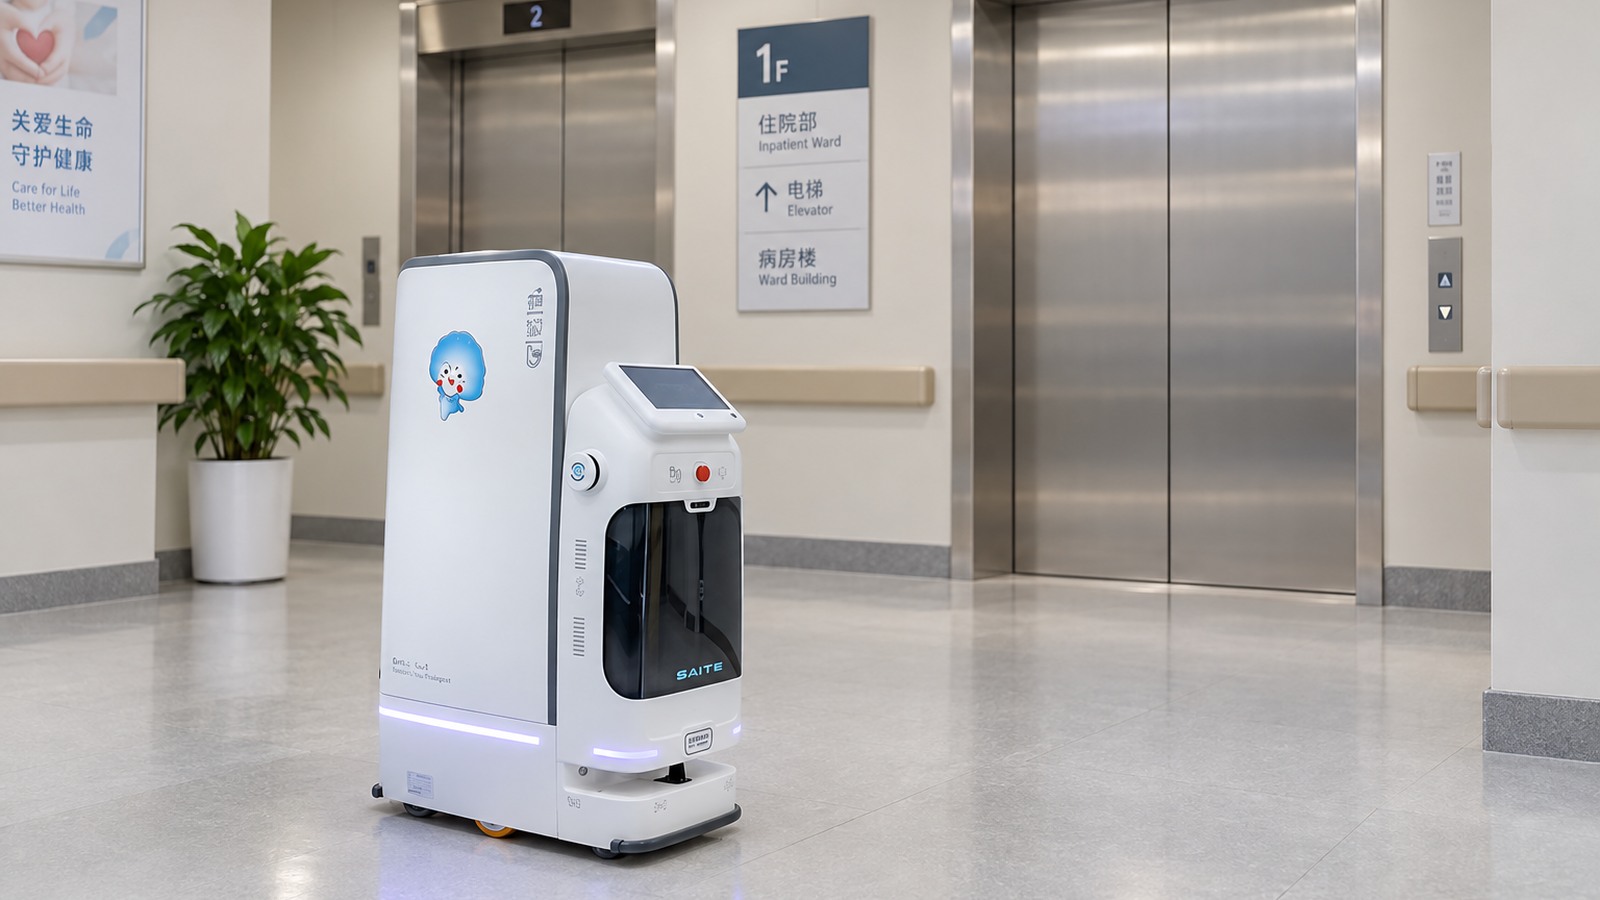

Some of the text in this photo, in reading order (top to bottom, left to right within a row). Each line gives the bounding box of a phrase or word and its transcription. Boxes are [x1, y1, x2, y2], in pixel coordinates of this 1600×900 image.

[530, 4, 543, 28] 2
[756, 43, 789, 84] 1F
[12, 109, 93, 140] 关爱生命
[759, 111, 817, 135] 住院部
[759, 135, 842, 154] Inpatient Ward
[12, 142, 93, 172] 守护健康
[12, 181, 80, 198] Care for Life
[788, 179, 823, 200] 电梯
[12, 198, 86, 215] Better Health
[788, 204, 833, 217] Elevator
[759, 247, 816, 269] 病房楼
[759, 273, 837, 288] Ward Building
[676, 661, 723, 681] SAITE
